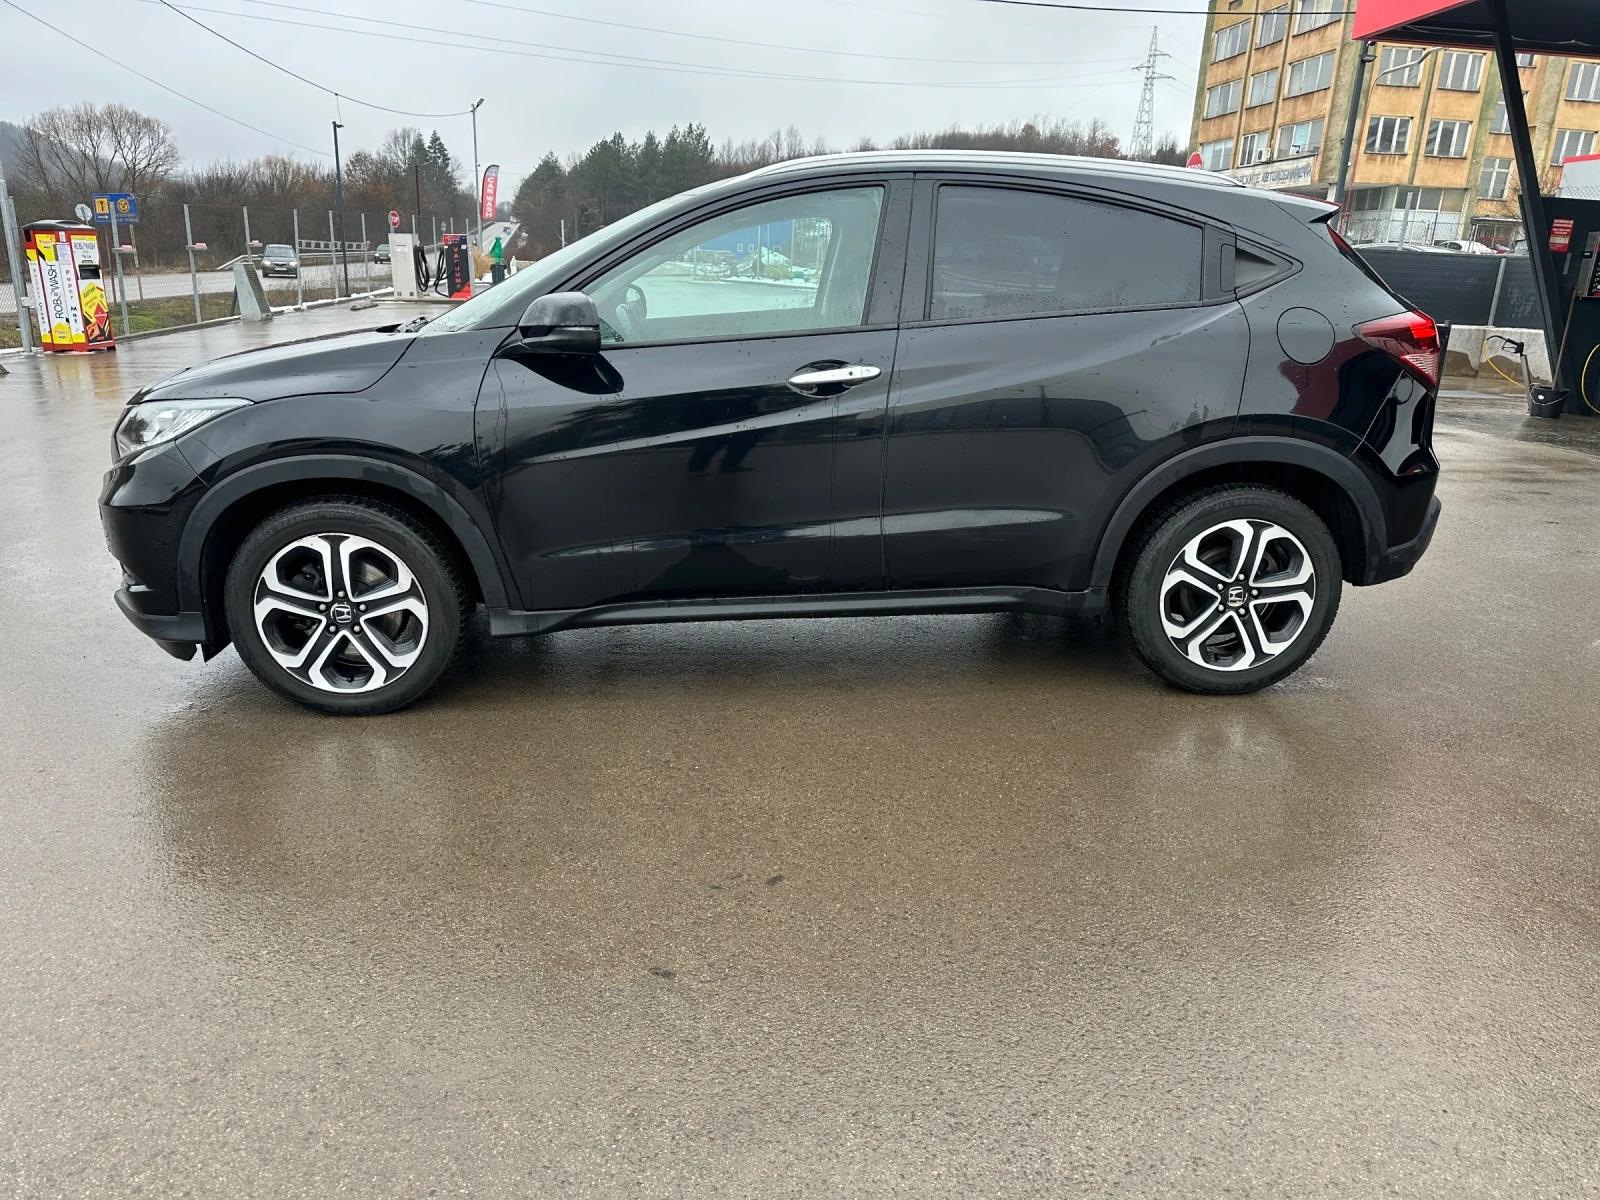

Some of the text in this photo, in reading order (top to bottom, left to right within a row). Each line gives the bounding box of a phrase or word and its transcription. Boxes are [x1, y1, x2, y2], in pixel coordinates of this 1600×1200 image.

[486, 177, 495, 194] CAR
[486, 195, 494, 217] WASH
[65, 270, 74, 299] Paper
[70, 306, 79, 324] Mat
